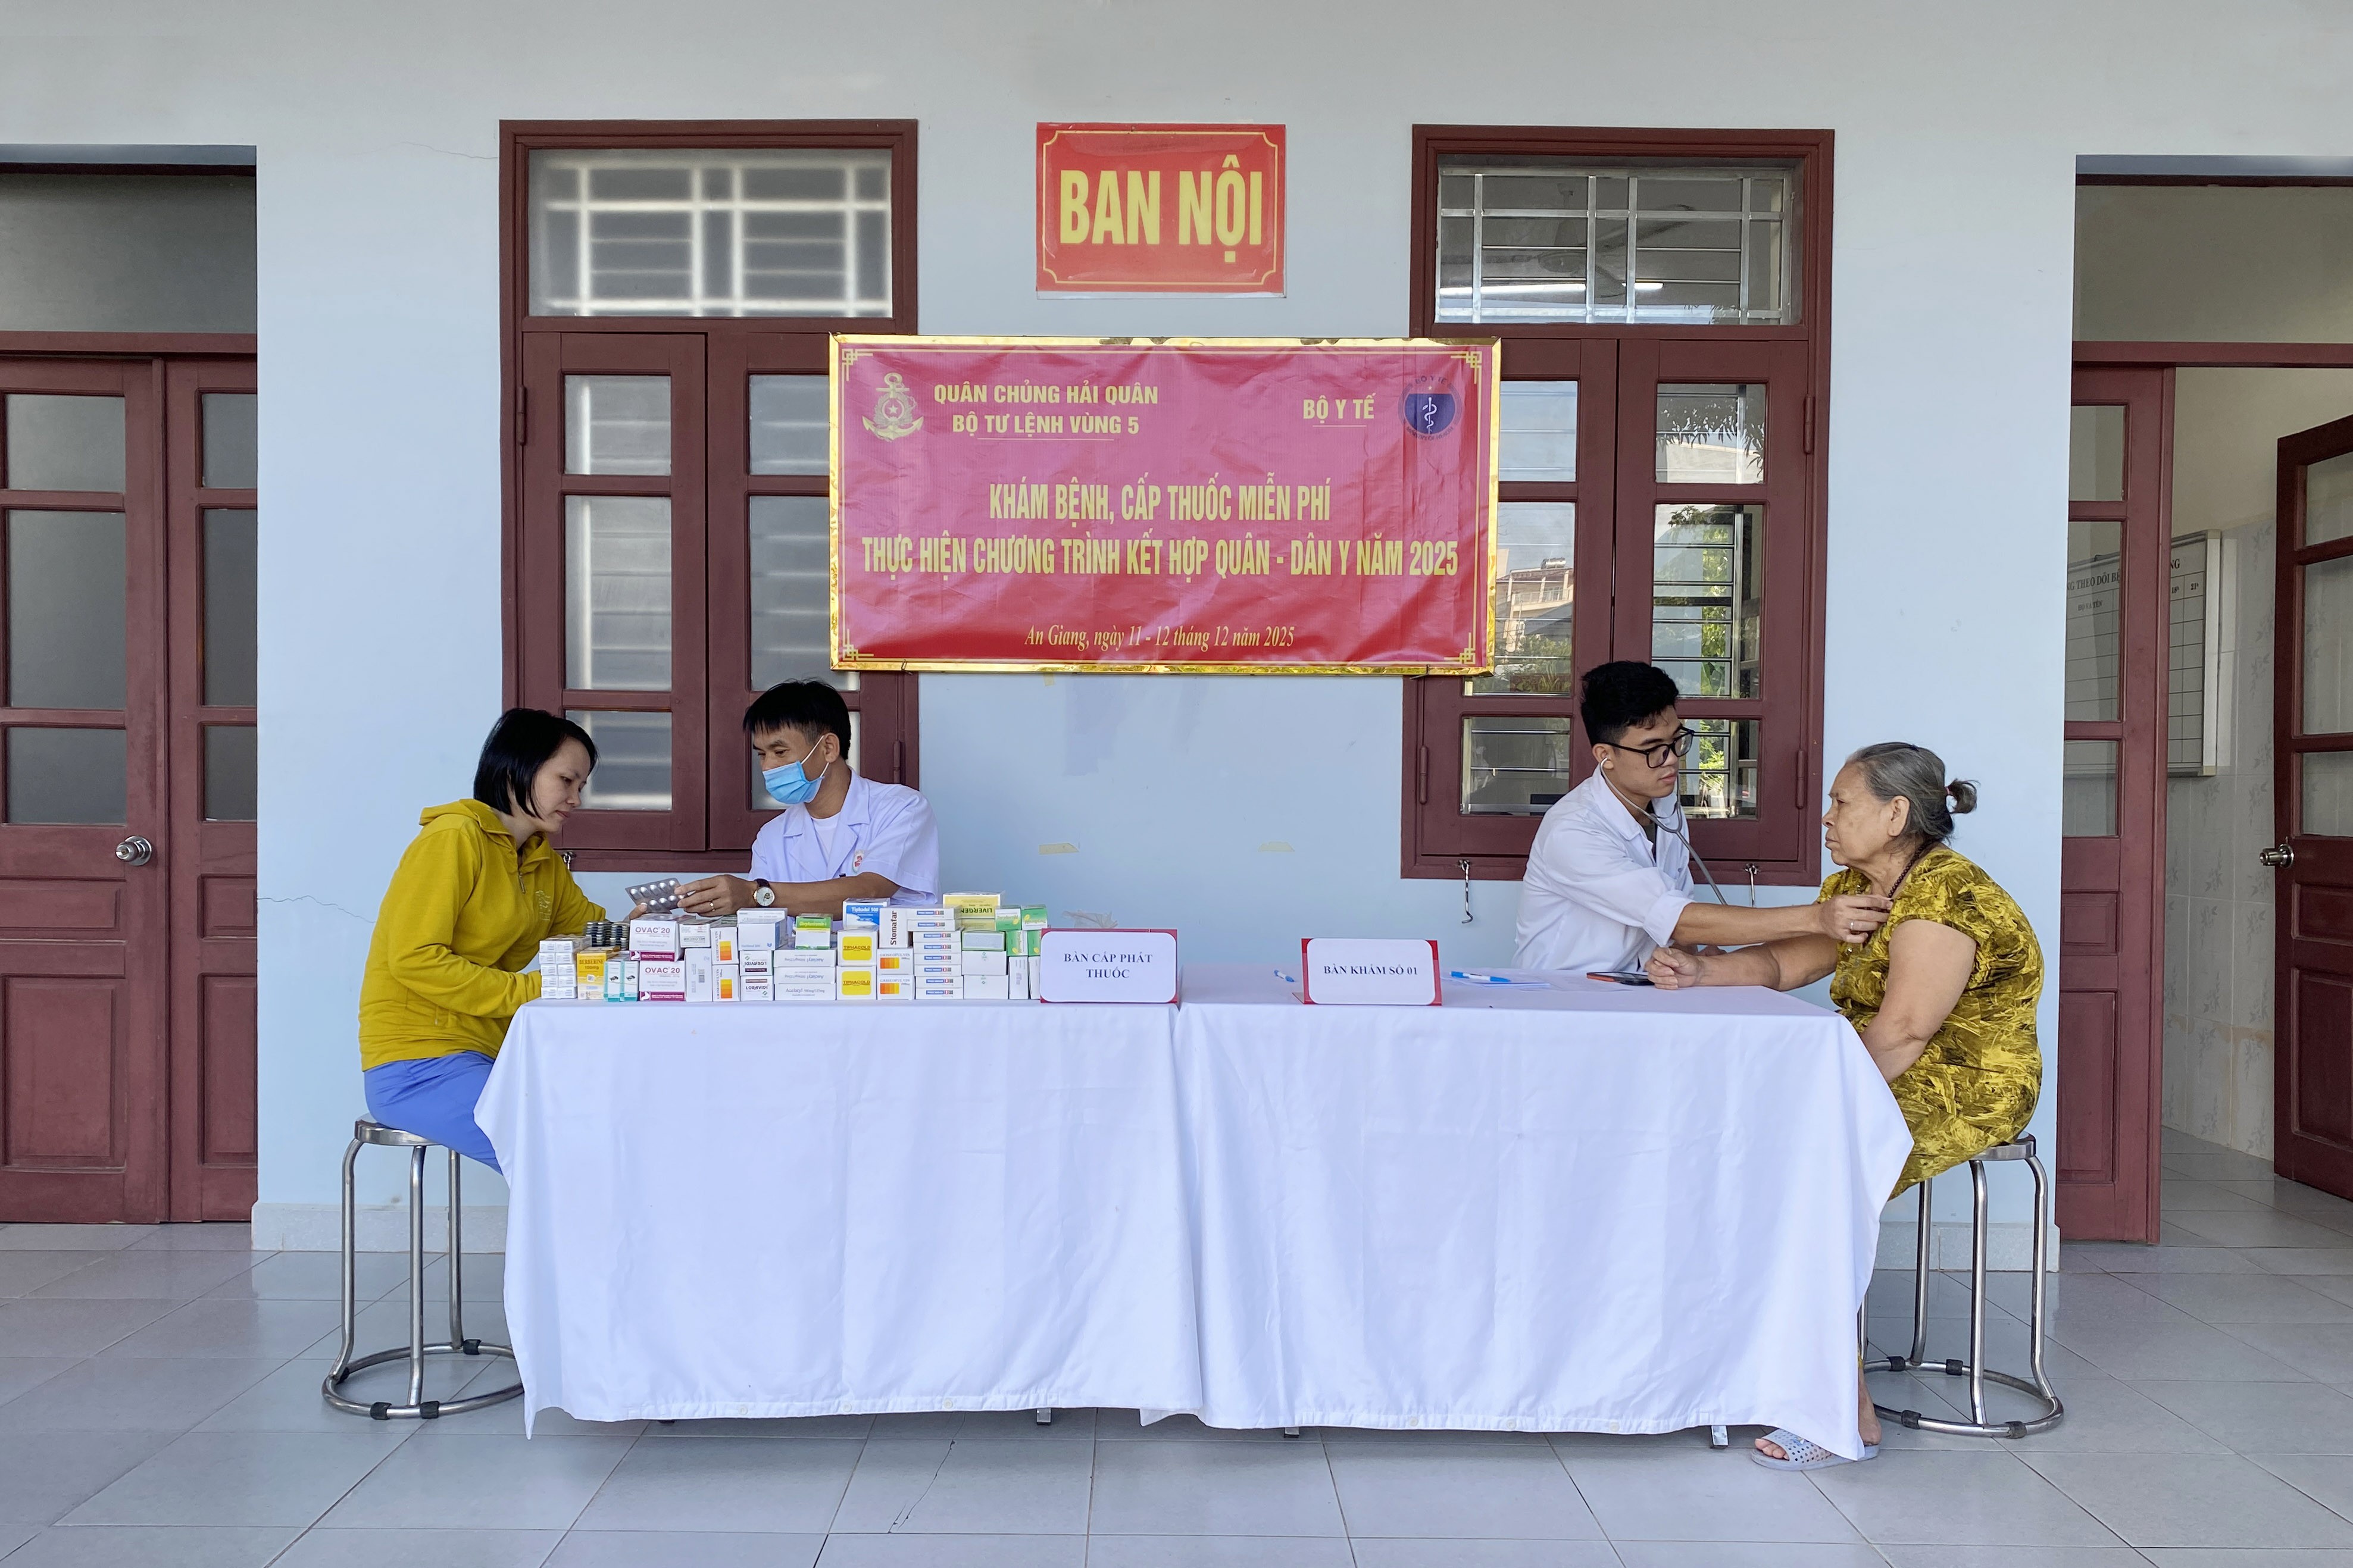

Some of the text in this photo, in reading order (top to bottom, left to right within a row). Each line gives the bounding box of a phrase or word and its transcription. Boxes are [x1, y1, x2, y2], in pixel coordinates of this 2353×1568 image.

[1060, 154, 1263, 262] BAN NỘI
[934, 379, 1158, 405] QUÂN CHỦNG HẢI QUÂN
[1303, 393, 1376, 423] BỘ Y TẾ
[953, 411, 1139, 437] BỘ TƯ LỆNH VÙNG 5
[990, 472, 1331, 528] KHÁM BỆNH, CẤP THUỐC MIỄN PHÍ
[862, 534, 913, 581] THỰC
[920, 530, 966, 581] HIỆN
[973, 534, 1055, 574] CHƯƠNG
[1061, 531, 1120, 574] TRÌNH
[1127, 528, 1163, 575] KẾT
[1169, 536, 1208, 583] HỢP
[1215, 532, 1270, 580] QUÂN
[1290, 532, 1332, 575] DÂN
[1338, 540, 1351, 575] Y
[1356, 533, 1403, 576] NĂM
[1410, 540, 1458, 576] 2025
[2076, 577, 2095, 590] THEO
[1024, 627, 1043, 645] An
[1048, 625, 1090, 651] Giang,
[1093, 625, 1124, 651] ngày
[1127, 625, 1141, 647] 11
[1154, 625, 1170, 647] 12
[1173, 625, 1210, 652] tháng
[1214, 625, 1229, 647] 12
[1232, 627, 1260, 647] năm
[1264, 625, 1295, 647] 2025
[1064, 951, 1088, 962] BÀN
[1120, 952, 1153, 962] PHÁT
[1324, 963, 1347, 974] BÀN
[1351, 963, 1386, 975] KHÁM
